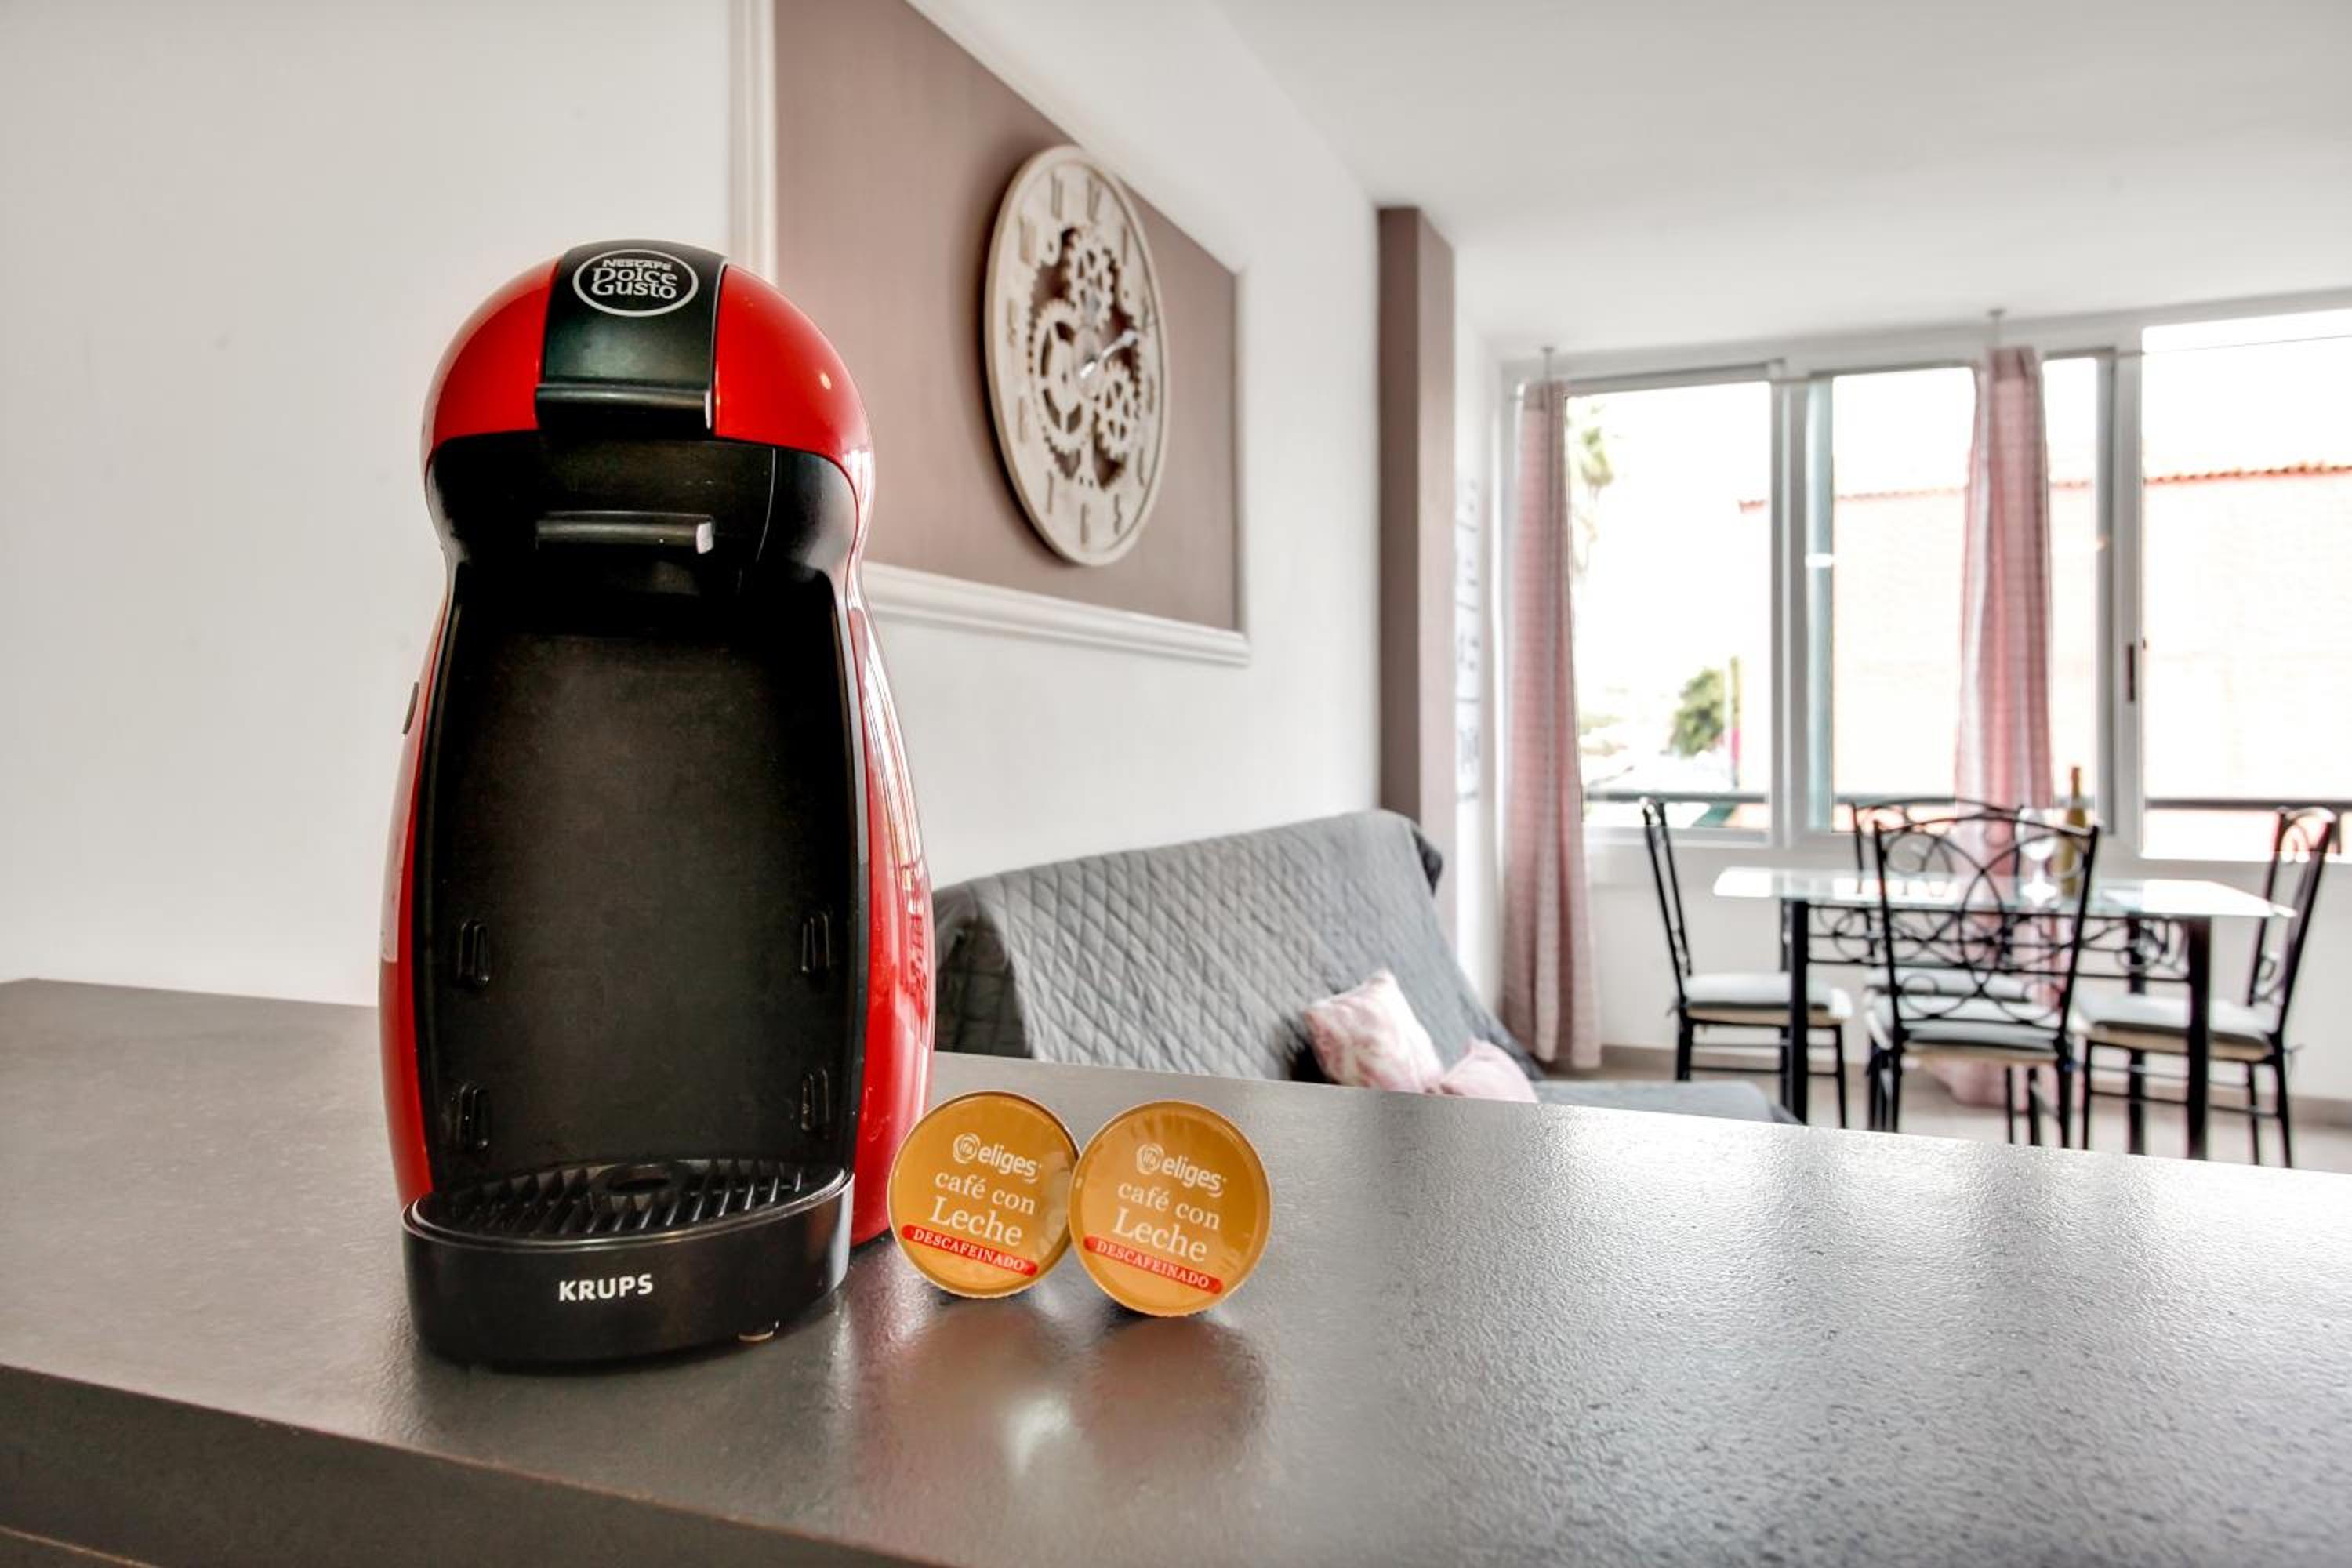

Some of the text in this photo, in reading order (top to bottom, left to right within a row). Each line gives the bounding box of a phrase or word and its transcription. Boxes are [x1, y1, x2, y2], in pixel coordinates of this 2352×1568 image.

[590, 280, 677, 300] Gusto
[592, 267, 678, 287] Dolce
[978, 1143, 1037, 1178] eliges
[1161, 1155, 1221, 1191] eliges
[935, 1172, 1036, 1216] café con
[1117, 1181, 1221, 1231] café con
[928, 1197, 1023, 1247] Leche
[1112, 1207, 1207, 1262] Leche
[913, 1230, 1026, 1272] DESCAFEINADO
[1095, 1241, 1210, 1290] DESCAFEINADO
[558, 1274, 654, 1302] KRUPS
